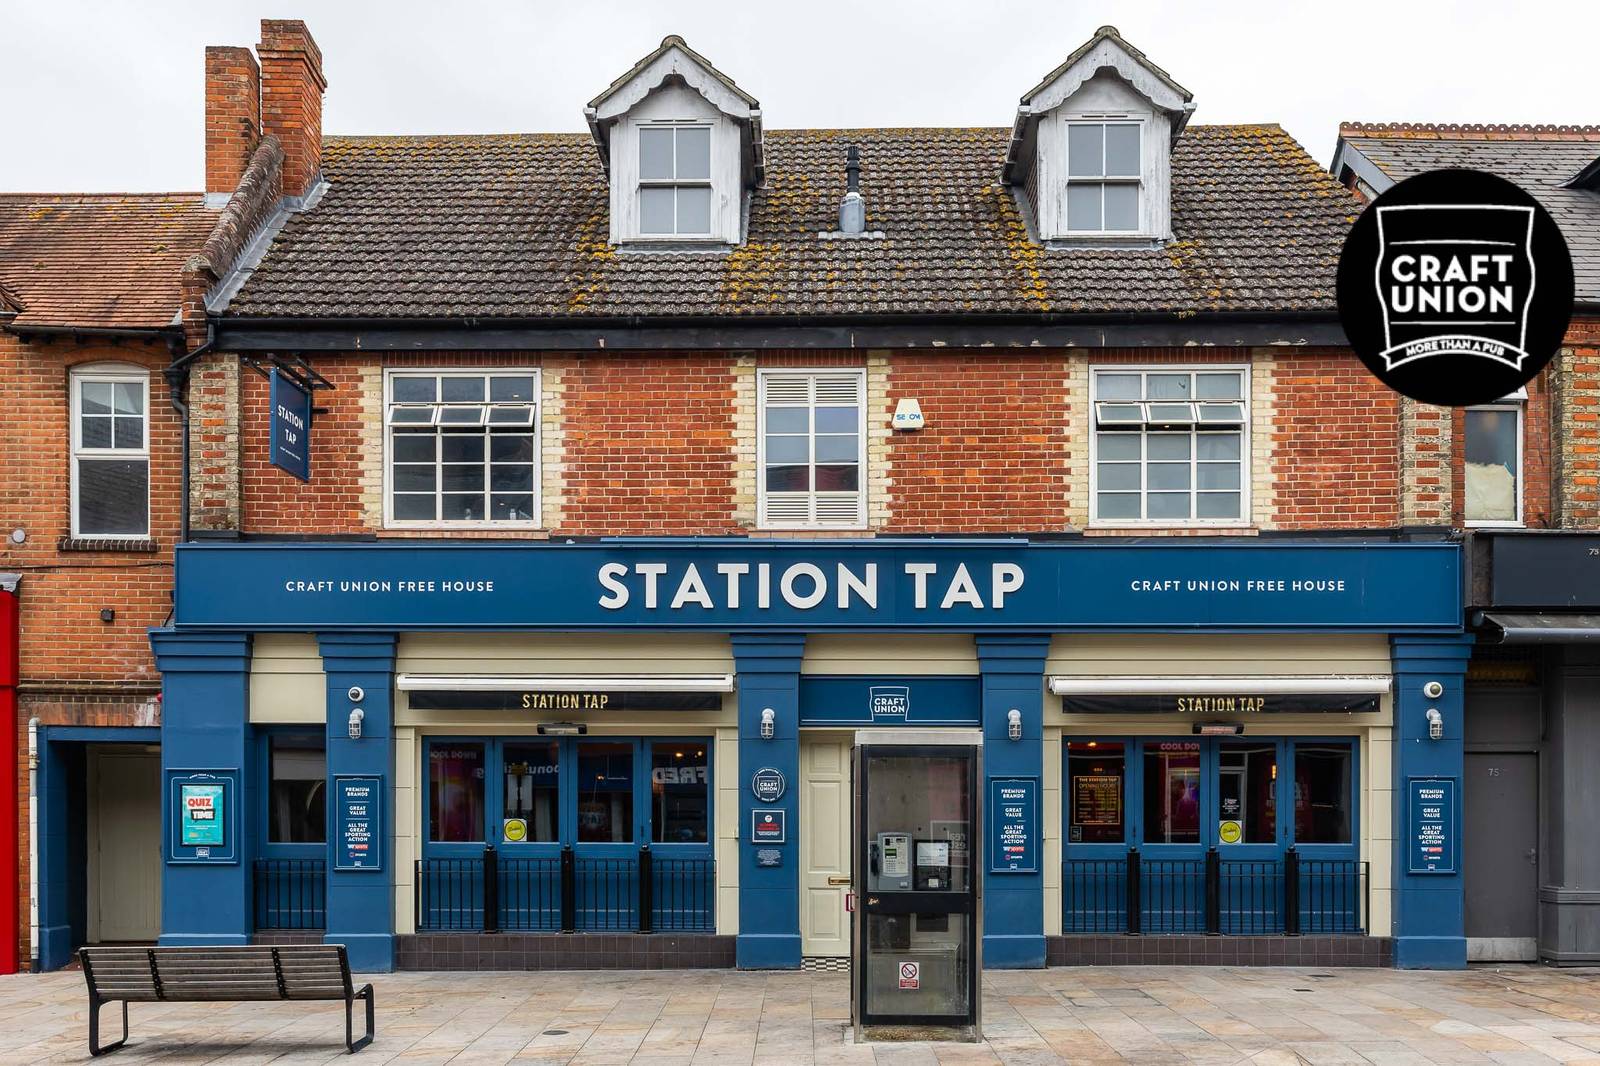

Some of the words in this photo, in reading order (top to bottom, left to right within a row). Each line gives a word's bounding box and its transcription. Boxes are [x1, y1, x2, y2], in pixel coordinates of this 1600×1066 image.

[277, 404, 304, 431] STATION
[284, 428, 297, 445] TAP
[285, 581, 334, 592] CRAFT
[340, 581, 391, 592] UNION
[398, 581, 435, 592] FREE
[442, 581, 494, 592] HOUSE
[597, 562, 878, 610] STATION
[903, 562, 1025, 610] TAP
[1131, 580, 1181, 592] CRAFT
[1187, 580, 1240, 592] UNION
[1247, 580, 1285, 592] FREE
[1292, 580, 1346, 592] HOUSE
[522, 694, 579, 709] STATION
[583, 694, 608, 709] TAP
[874, 697, 905, 706] CRAFT
[1178, 697, 1235, 712] STATION
[1239, 697, 1265, 712] TAP
[874, 705, 905, 713] UNION
[1488, 767, 1500, 777] 75
[187, 798, 212, 807] QUIZ
[192, 810, 214, 819] TIME
